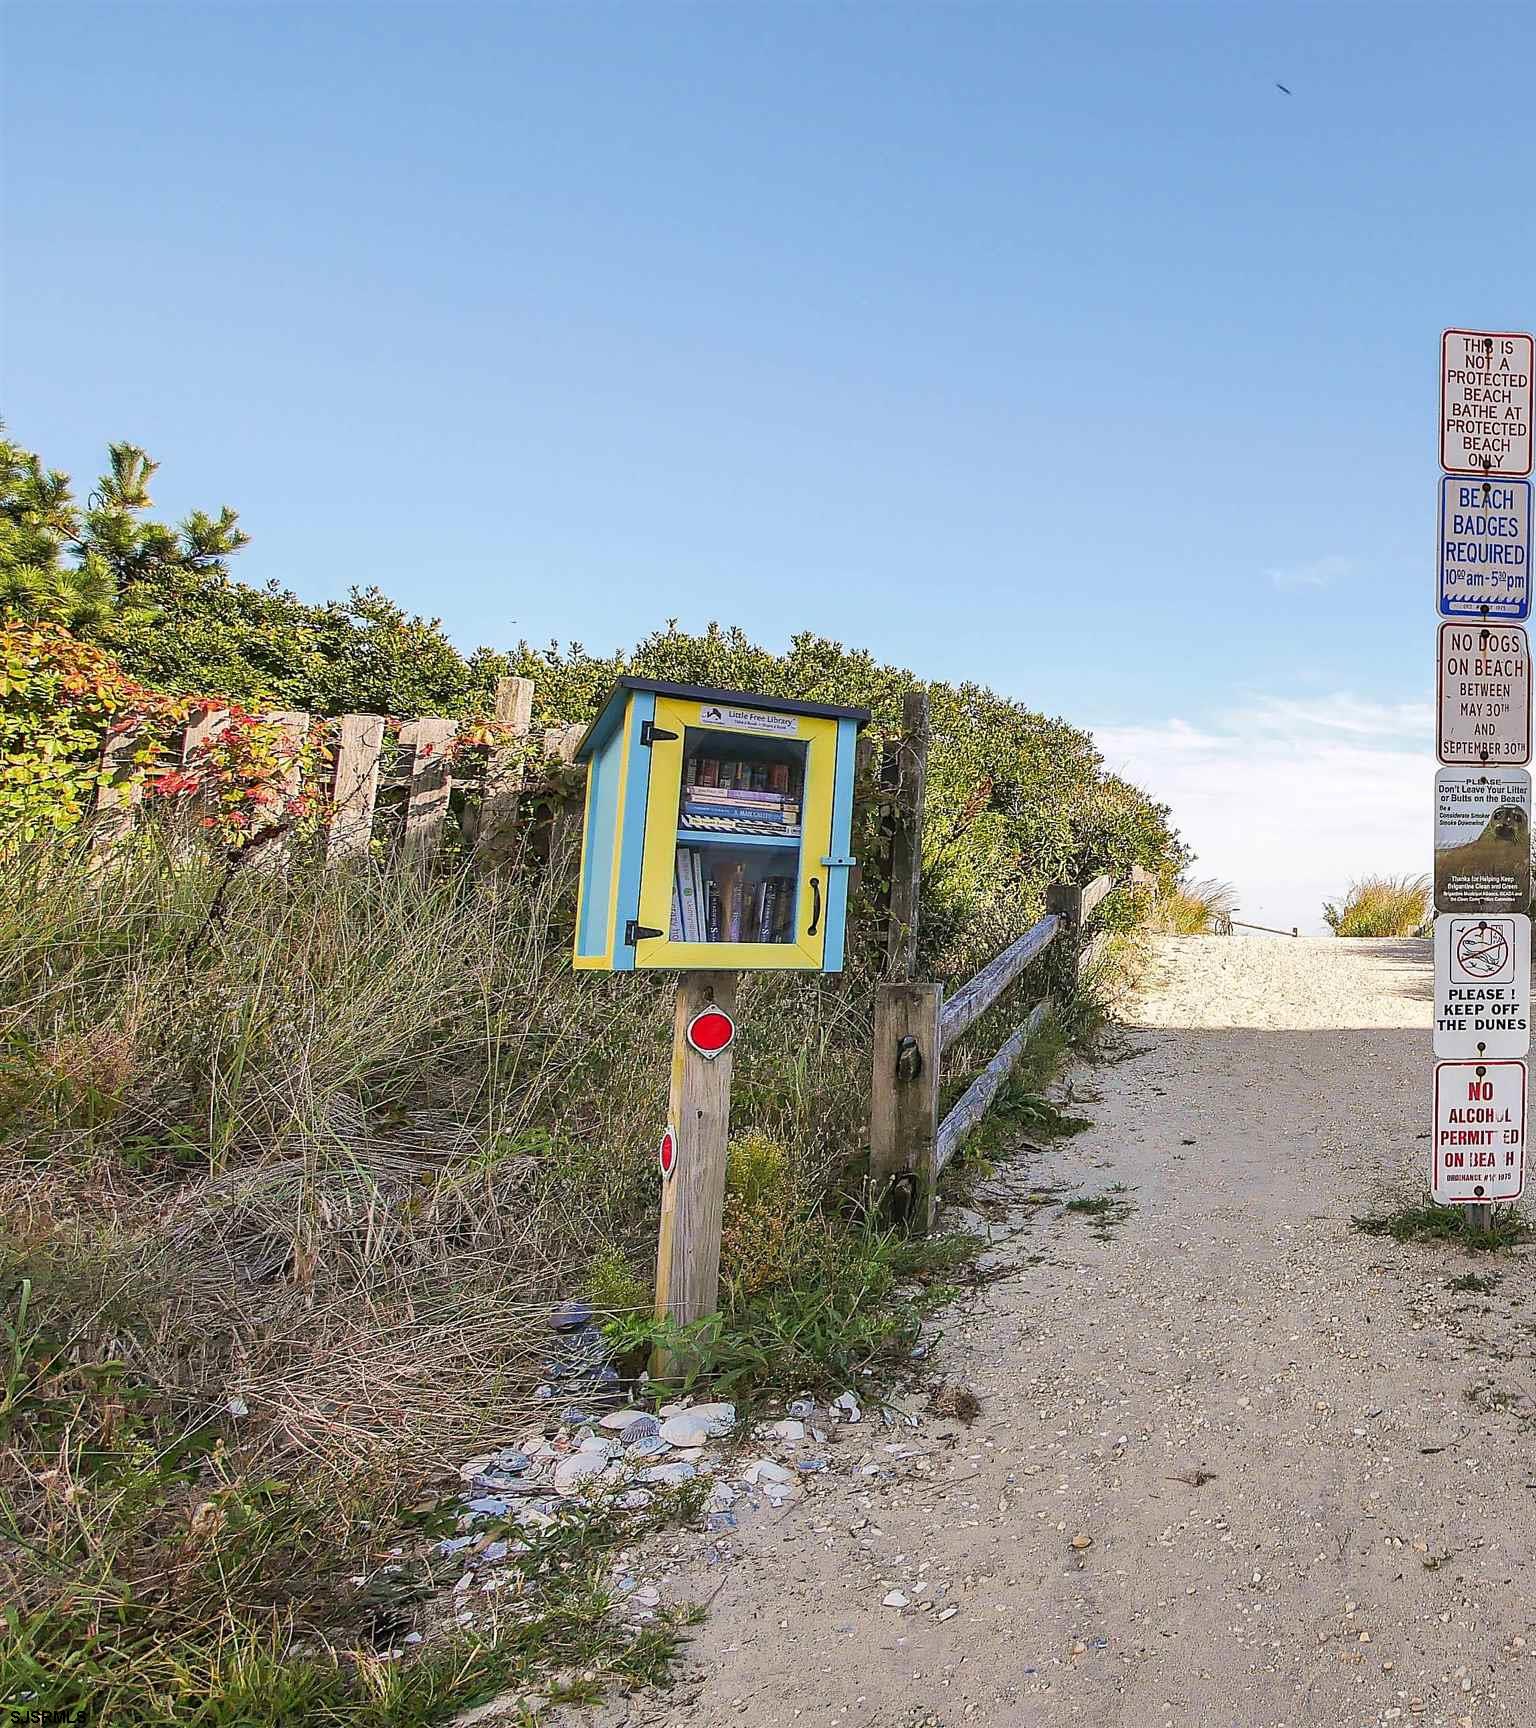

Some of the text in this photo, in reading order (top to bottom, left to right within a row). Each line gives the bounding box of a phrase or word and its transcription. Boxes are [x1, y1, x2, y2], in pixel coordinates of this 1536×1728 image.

[1501, 341, 1514, 354] IS
[1466, 354, 1510, 370] NOT A
[1448, 370, 1528, 388] PROTECTED
[1464, 388, 1511, 403] BEACH
[1452, 403, 1522, 420] BATHE AT
[1447, 420, 1526, 436] PROTECTED
[1463, 437, 1510, 452] BEACH
[1469, 454, 1504, 468] ONLY
[1460, 488, 1513, 509] BEACH
[1454, 515, 1518, 537] BADGES
[1446, 542, 1524, 565] REQUIRED
[1452, 634, 1520, 652] NO DOGS
[1448, 658, 1523, 677] ON BEACH
[1460, 682, 1510, 696] BETWEEN
[729, 711, 748, 719] Little
[1460, 703, 1482, 717] MAY
[1474, 724, 1495, 736] AND
[1443, 742, 1500, 754] SEPTEMBER
[1439, 785, 1459, 793] Don't
[1449, 989, 1515, 1000] PLEASE !
[1444, 1004, 1519, 1015] KEEP OFF
[1437, 1019, 1526, 1030] THE DUNES
[1468, 1082, 1493, 1100] NO
[1449, 1107, 1512, 1123] ALCOHL
[1440, 1130, 1519, 1145] PERMITED
[1445, 1152, 1514, 1167] ON BEAH
